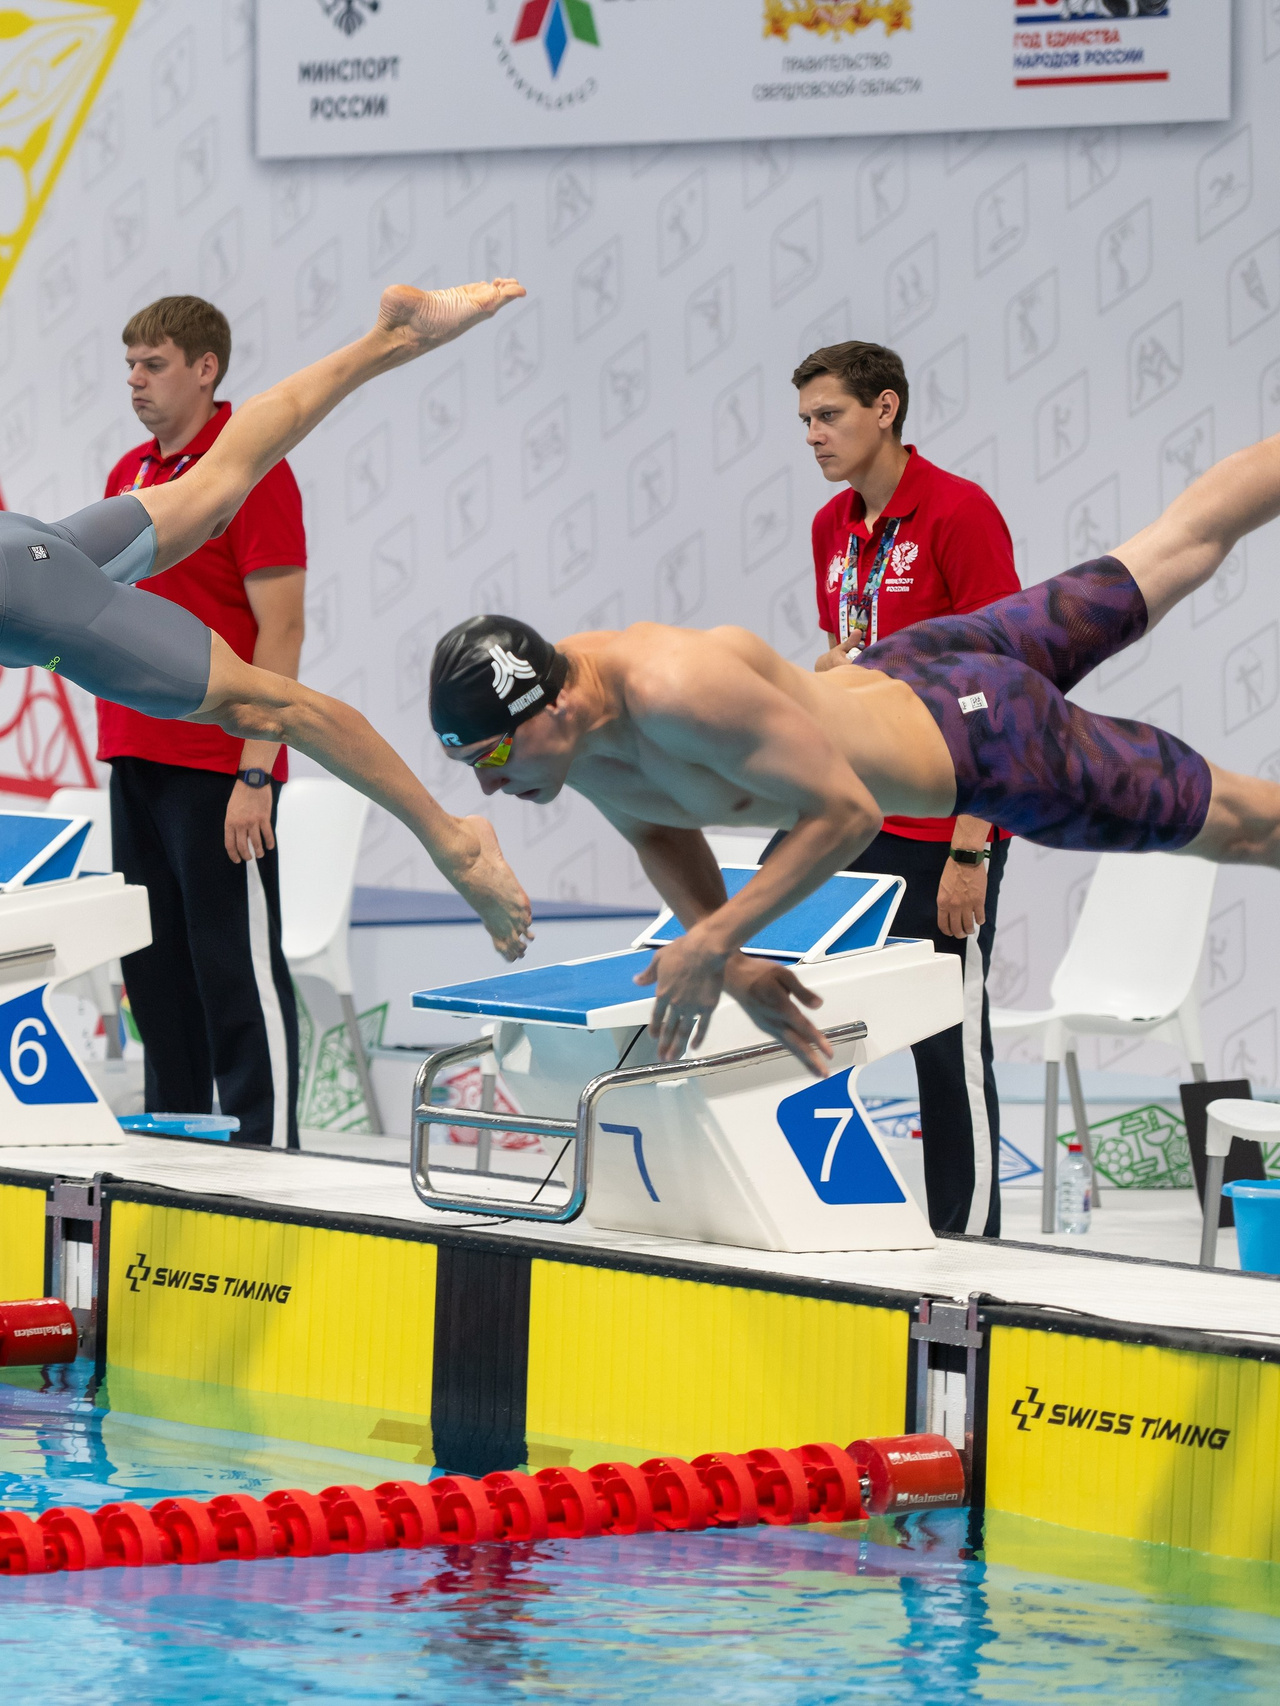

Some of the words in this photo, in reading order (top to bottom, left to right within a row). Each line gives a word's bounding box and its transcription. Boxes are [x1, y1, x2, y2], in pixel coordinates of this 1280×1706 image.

[1013, 33, 1042, 49] ГОД
[1045, 28, 1121, 49] ЕДИНСТВА
[298, 56, 401, 84] МИНСПОРТ
[1013, 51, 1081, 70] НАРОДОВ
[1083, 48, 1145, 66] РОССИИ
[310, 95, 390, 121] РОССИИ
[10, 1017, 48, 1086] 6
[814, 1108, 854, 1183] 7
[598, 1122, 661, 1203] 7
[152, 1267, 220, 1294] SWISS
[223, 1277, 292, 1304] TIMING
[1047, 1403, 1135, 1436] SWISS
[1140, 1417, 1231, 1451] TIMING
[900, 1450, 953, 1462] Malmsten
[909, 1492, 958, 1504] Malmsten
